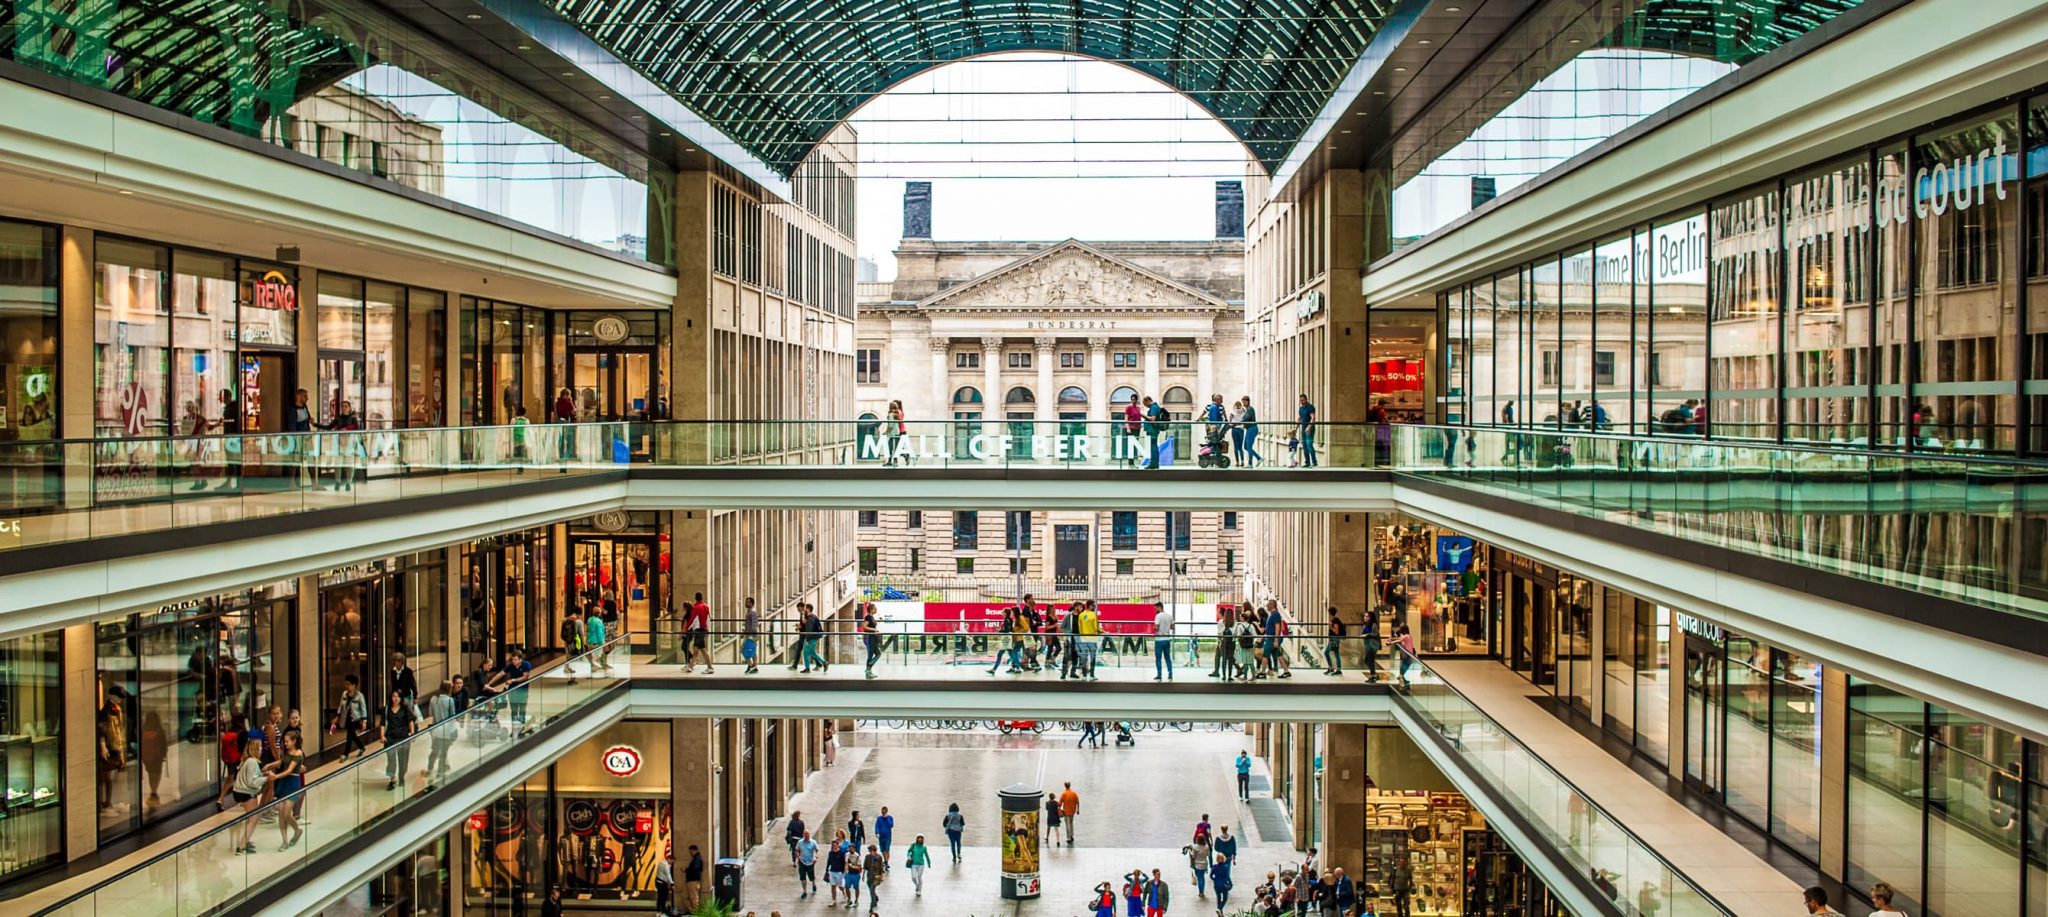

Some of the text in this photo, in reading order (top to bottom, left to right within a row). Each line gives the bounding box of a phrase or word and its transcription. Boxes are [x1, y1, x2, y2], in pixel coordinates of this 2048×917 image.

[256, 280, 296, 312] RENO
[1028, 321, 1116, 329] BUNDESRAT
[862, 434, 1151, 460] MALL OF BERLIN
[609, 755, 632, 768] C&A
